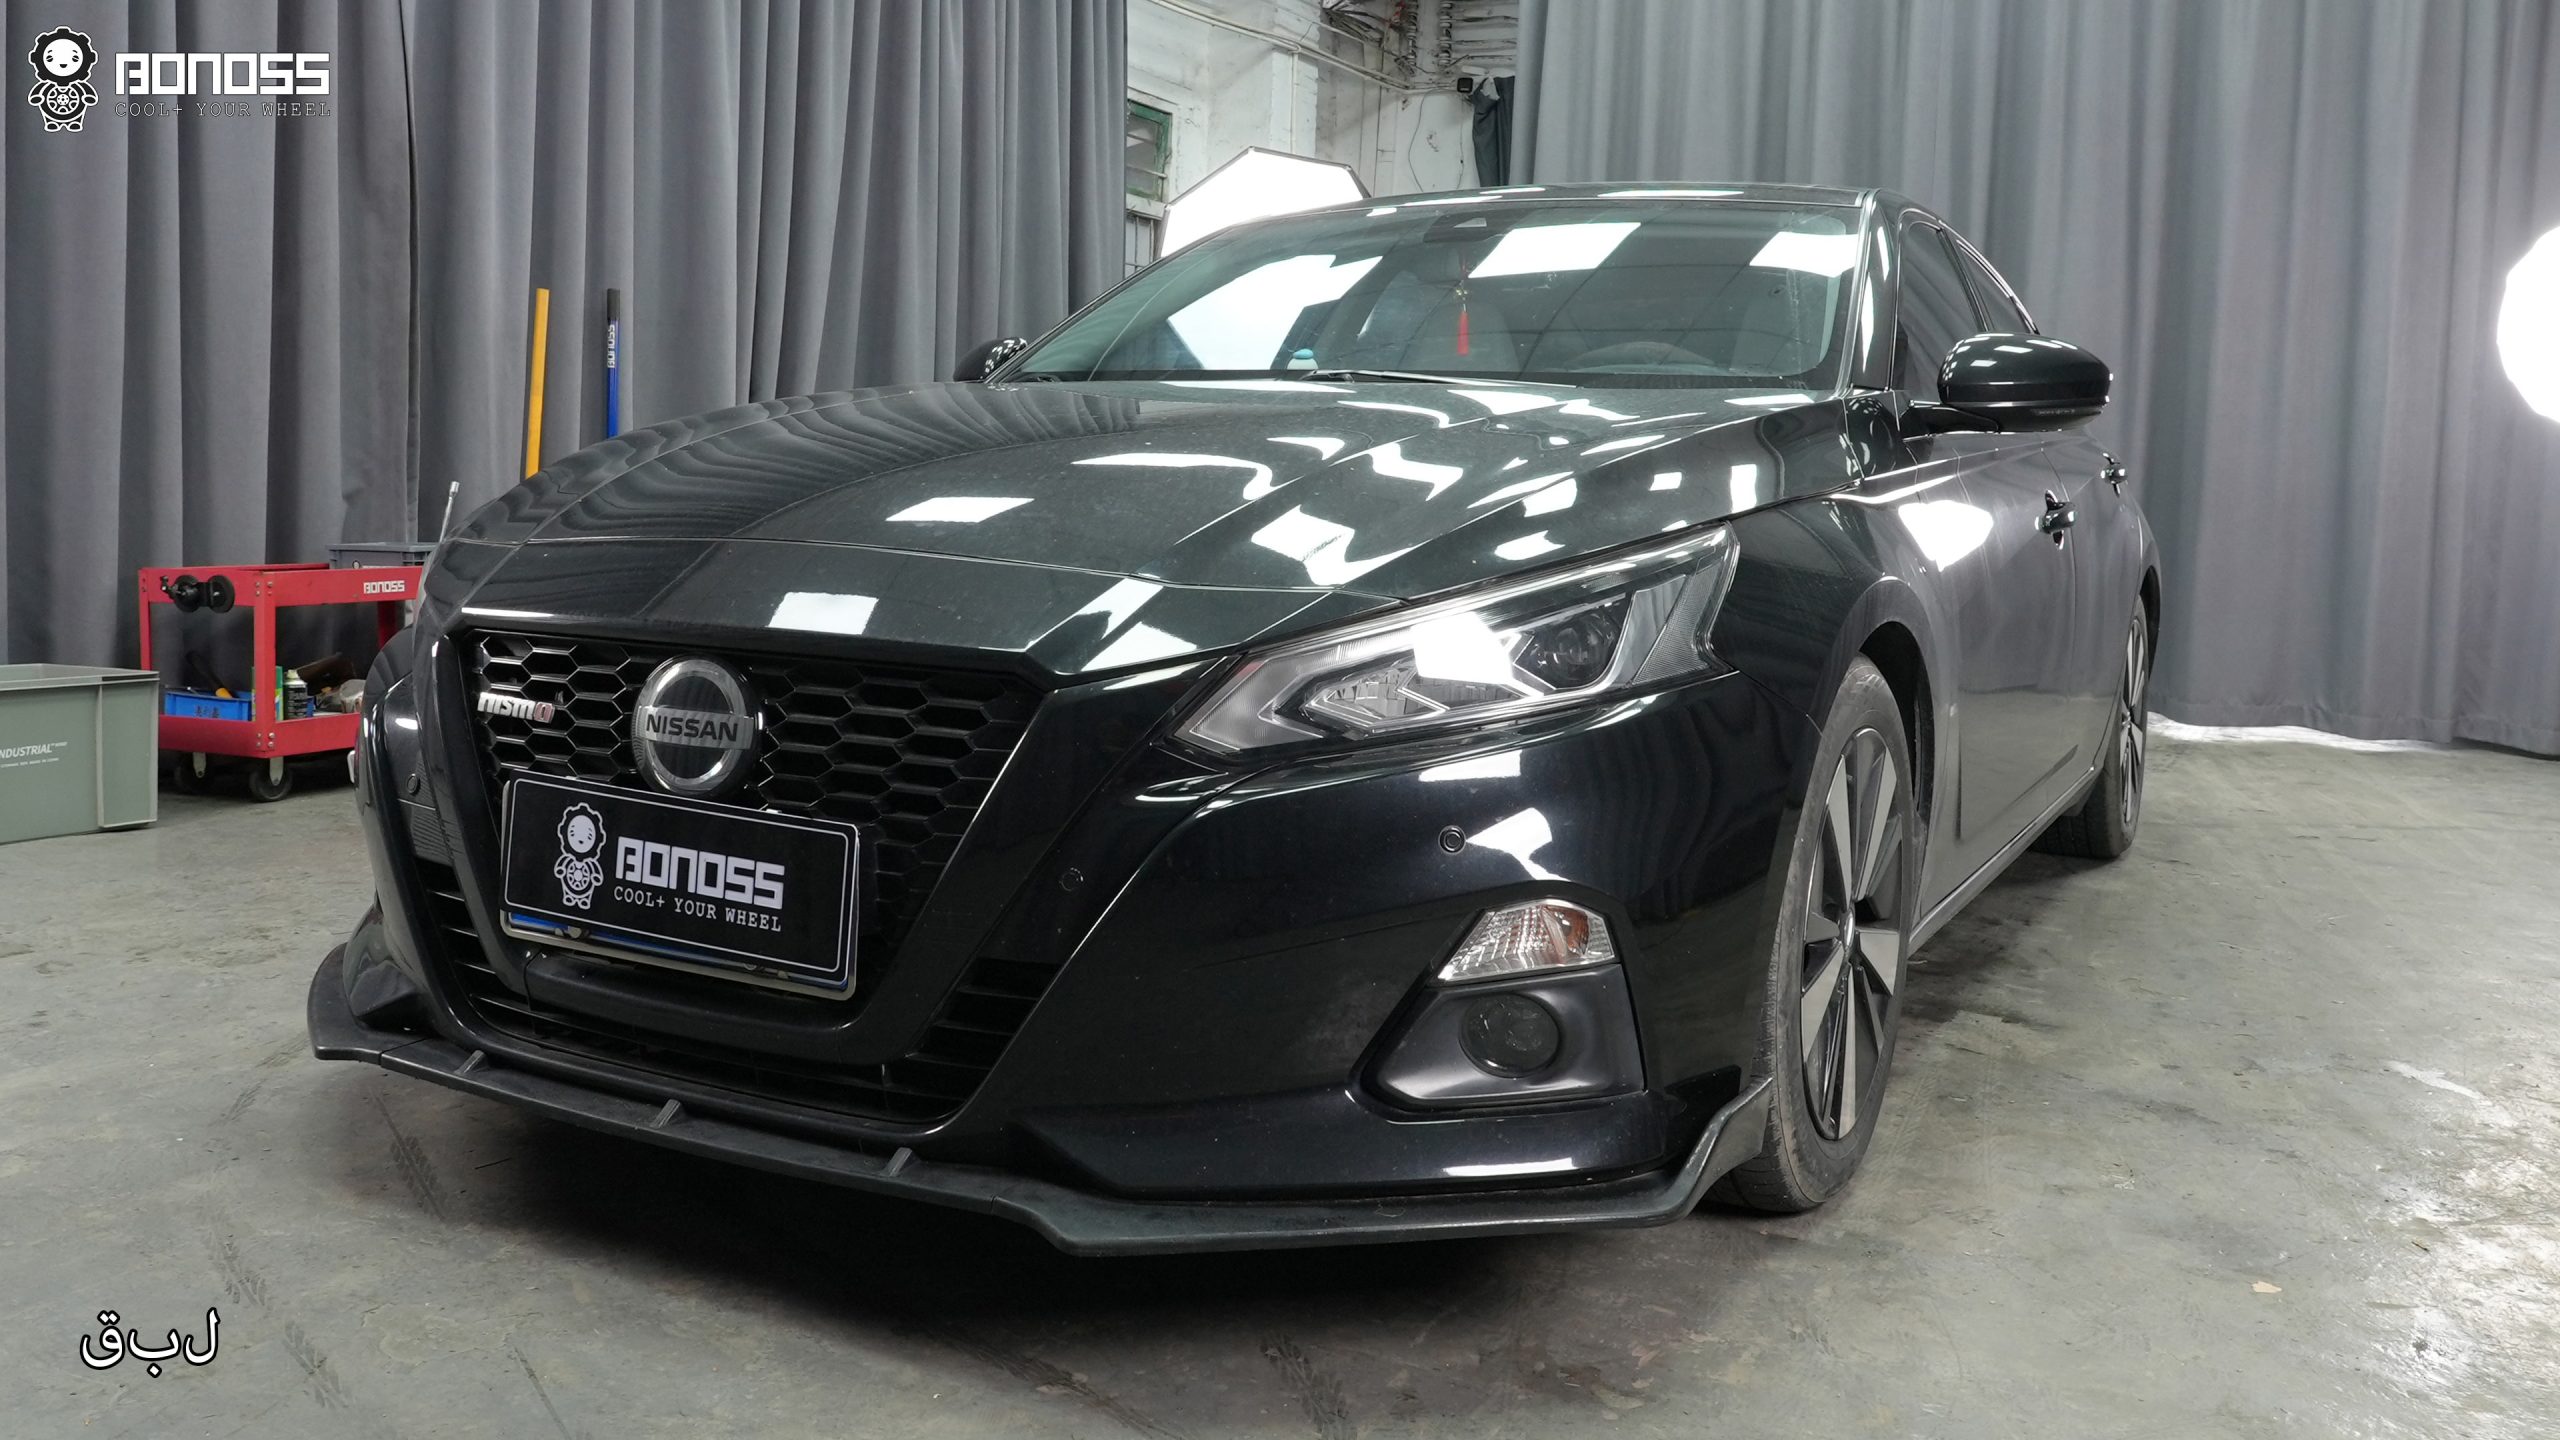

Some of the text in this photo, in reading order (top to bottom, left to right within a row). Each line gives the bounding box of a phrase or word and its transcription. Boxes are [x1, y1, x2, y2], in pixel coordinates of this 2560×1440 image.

[363, 580, 405, 594] BONOSS
[646, 713, 739, 742] NISSAN
[615, 836, 785, 910] BONOSS
[613, 885, 782, 933] COOL+ YOUR WHEEL
